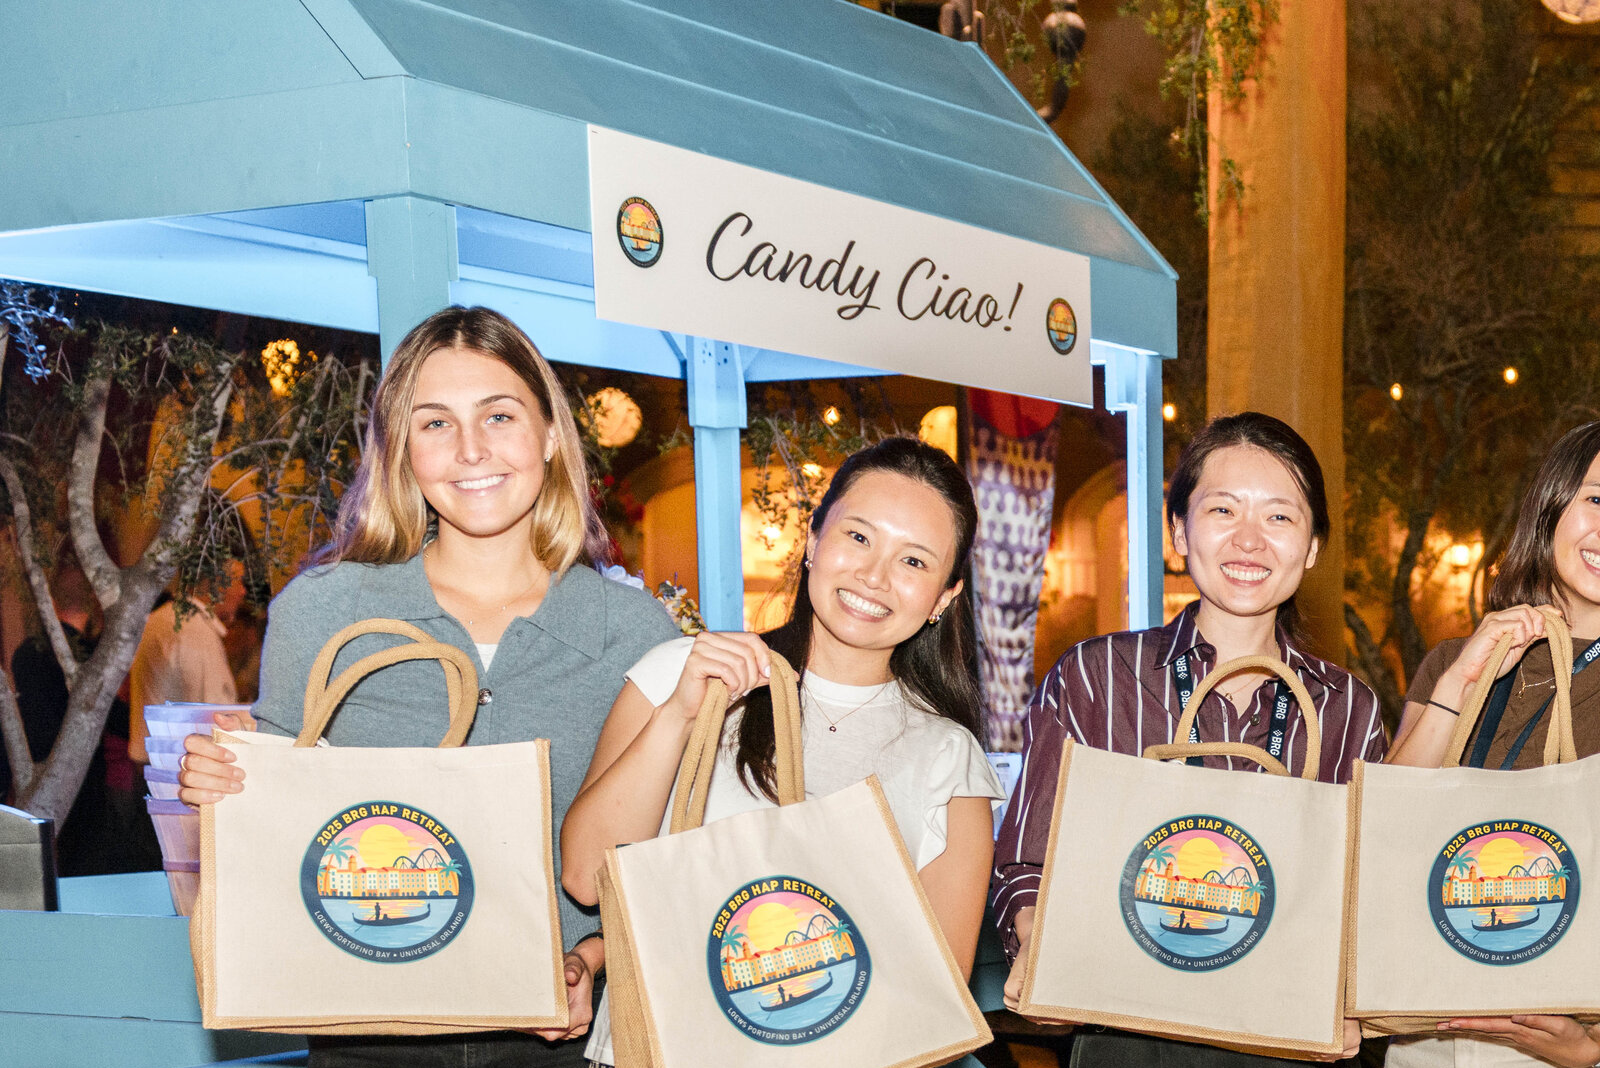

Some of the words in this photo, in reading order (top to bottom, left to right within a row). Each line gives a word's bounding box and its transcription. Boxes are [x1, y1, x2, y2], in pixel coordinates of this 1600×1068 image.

[706, 212, 880, 320] Candy
[896, 257, 1023, 332] Ciao!
[1275, 701, 1287, 720] BRG
[1270, 736, 1282, 756] BRG
[317, 820, 343, 846] 2025
[342, 807, 368, 824] BRG
[371, 805, 398, 815] HAP
[402, 808, 455, 847] RETREAT
[1144, 828, 1169, 850] 2025
[1170, 819, 1194, 834] BRG
[1198, 819, 1222, 830] HAP
[1224, 825, 1267, 868] RETREAT
[1443, 835, 1466, 858] 2025
[1467, 825, 1491, 838] BRG
[1494, 822, 1519, 832] HAP
[1522, 825, 1567, 854] RETREAT
[712, 911, 731, 938] 2025
[728, 890, 750, 912] BRG
[751, 880, 779, 896] HAP
[783, 879, 835, 908] RETREAT
[315, 911, 333, 933] LOEWS
[333, 932, 373, 956] PORTOFINO
[376, 950, 390, 958] BAY
[400, 940, 440, 958] UNIVERSAL
[440, 911, 464, 941] ORLANDO
[1127, 912, 1140, 935] LOEWS
[1139, 934, 1171, 961] PORTOFINO
[1173, 957, 1186, 966] BAY
[1194, 955, 1231, 967] UNIVERSAL
[1232, 931, 1259, 957] ORLANDO
[1439, 920, 1455, 940] LOEWS
[1455, 939, 1489, 959] PORTOFINO
[1512, 941, 1548, 960] UNIVERSAL
[1547, 914, 1570, 942] ORLANDO
[728, 1008, 747, 1028] LOEWS
[747, 1025, 789, 1040] PORTOFINO
[792, 1032, 807, 1040] BAY
[815, 1006, 851, 1033] UNIVERSAL
[848, 971, 866, 1005] ORLANDO
